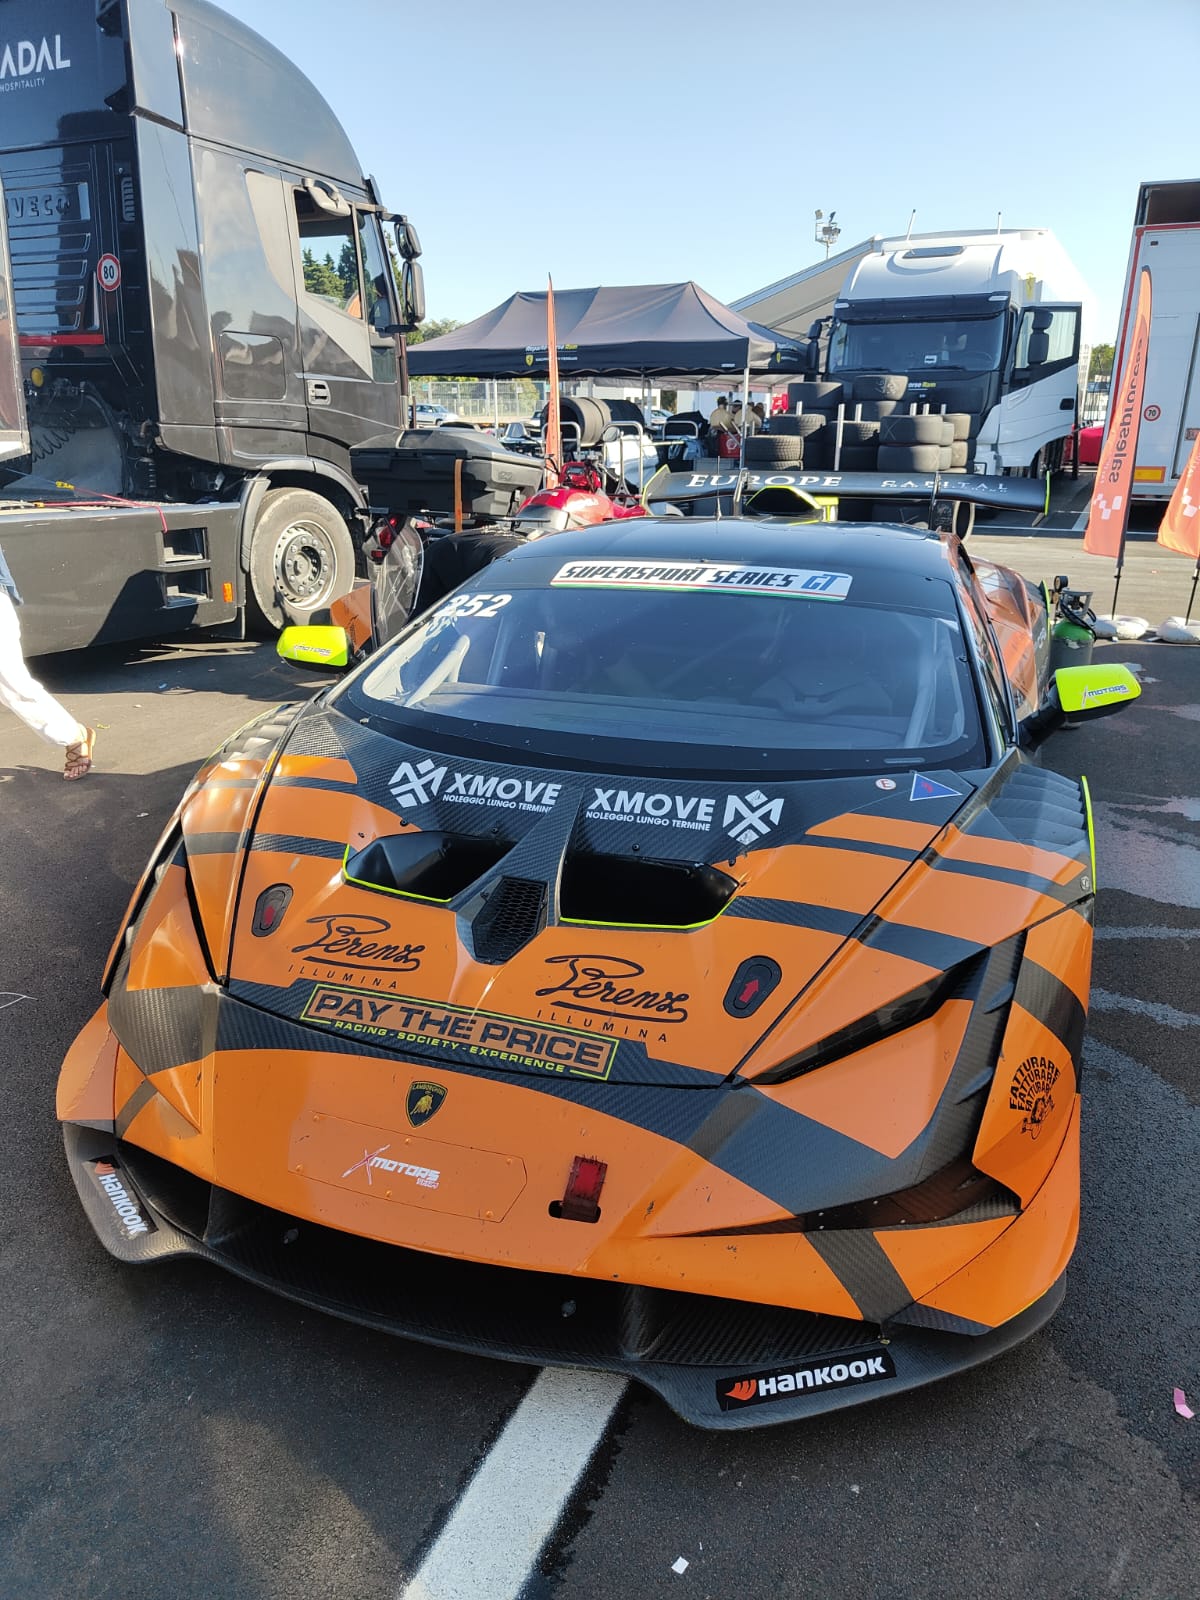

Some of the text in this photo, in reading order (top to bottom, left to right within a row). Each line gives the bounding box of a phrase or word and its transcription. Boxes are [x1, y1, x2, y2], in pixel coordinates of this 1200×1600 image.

[103, 265, 115, 280] 80
[1148, 409, 1157, 417] 70
[559, 566, 850, 591] SUPERSPORT SERIES GT
[442, 794, 485, 805] NOLEGGIO
[487, 798, 516, 809] LUNGO
[444, 772, 562, 805] XMOVE
[587, 787, 716, 822] XMOVE
[585, 811, 711, 831] NOLEGGIO LUNGO TERMINE
[288, 964, 398, 989] ILLUMINA
[314, 993, 604, 1068] PAY THE PRICE
[536, 1009, 668, 1042] ILLUMINA
[333, 1021, 387, 1037] RACING
[396, 1032, 460, 1050] SOCIETY
[469, 1046, 565, 1073] EXPERIENCE
[1009, 1056, 1061, 1110] FATTURARE
